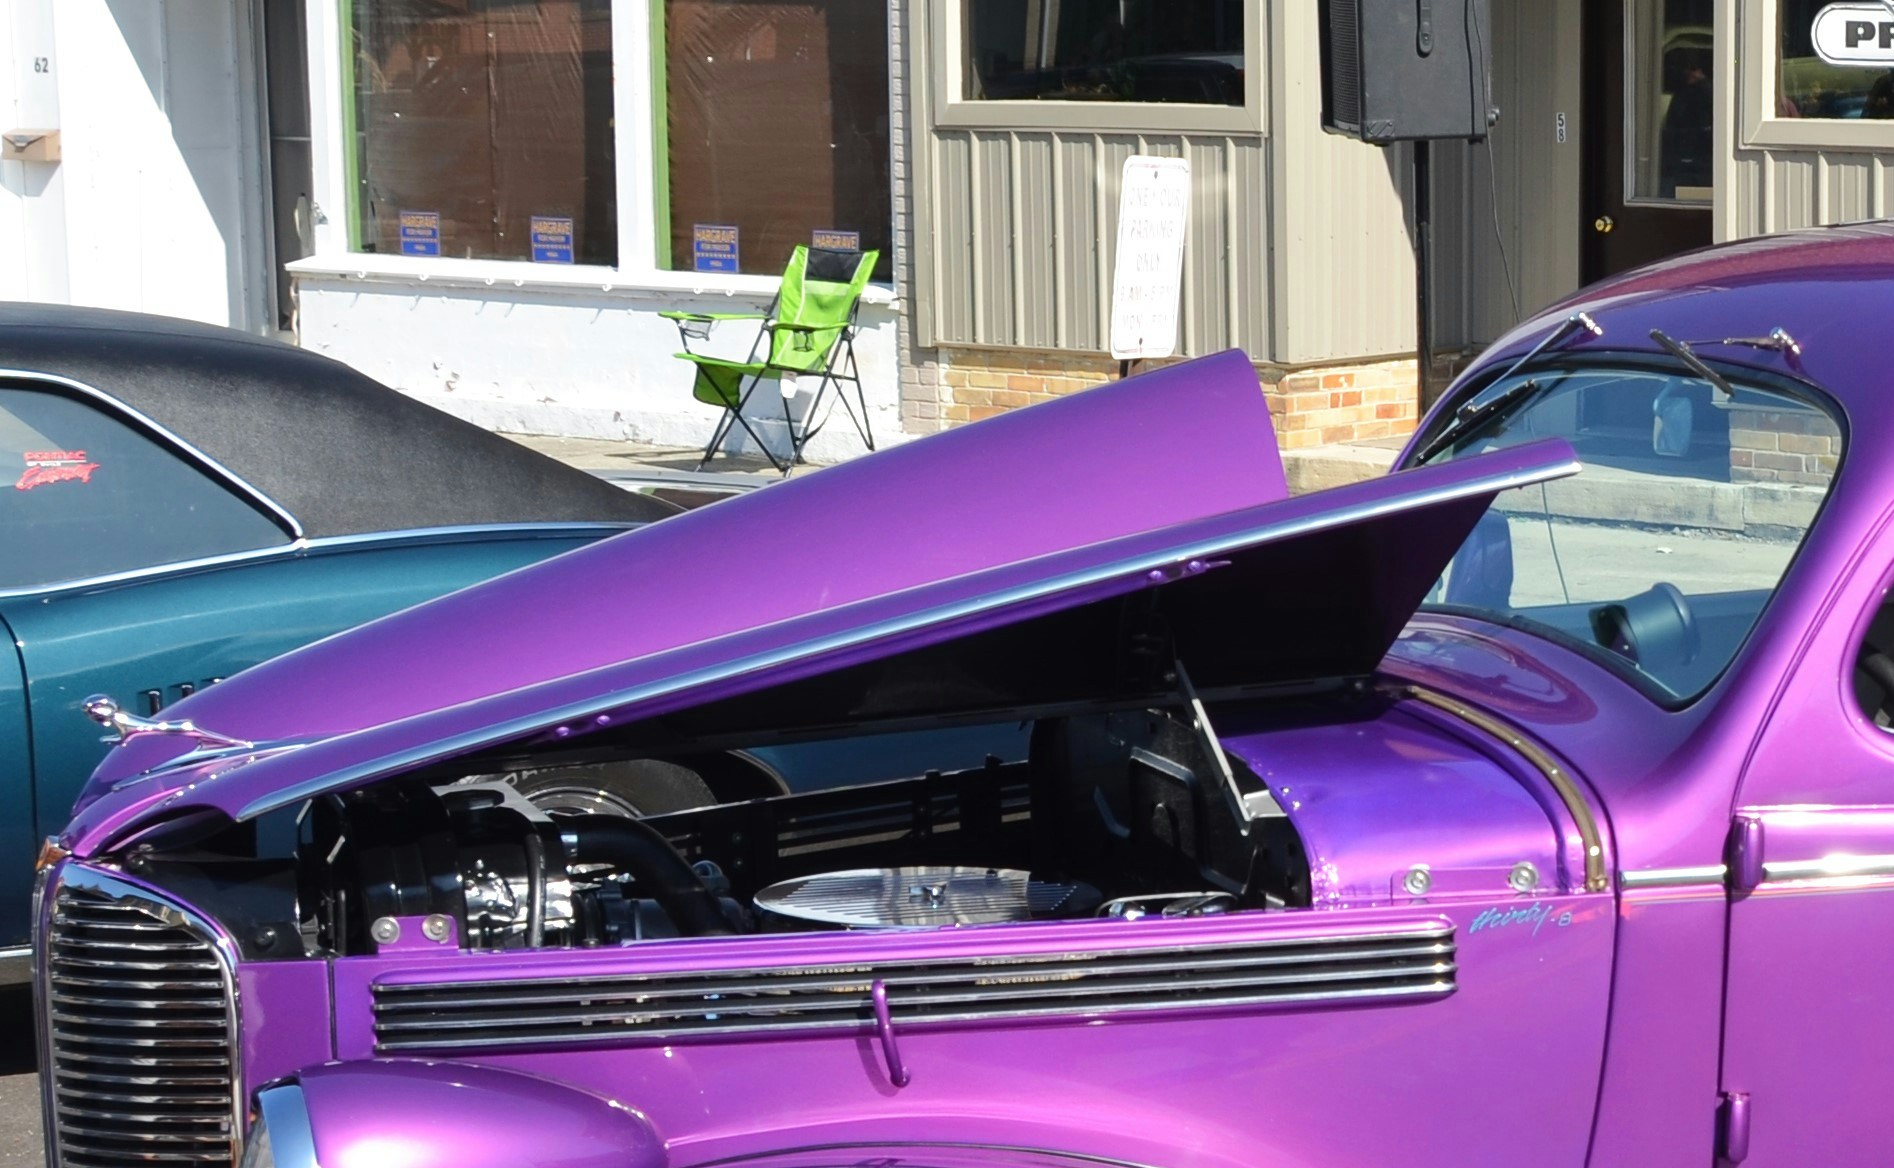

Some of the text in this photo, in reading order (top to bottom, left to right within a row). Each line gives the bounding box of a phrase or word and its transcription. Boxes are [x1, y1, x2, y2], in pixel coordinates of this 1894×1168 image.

[34, 56, 49, 74] 62
[1557, 113, 1565, 142] 58
[695, 229, 736, 243] HARGRAVE
[814, 235, 857, 249] HARGRAVE
